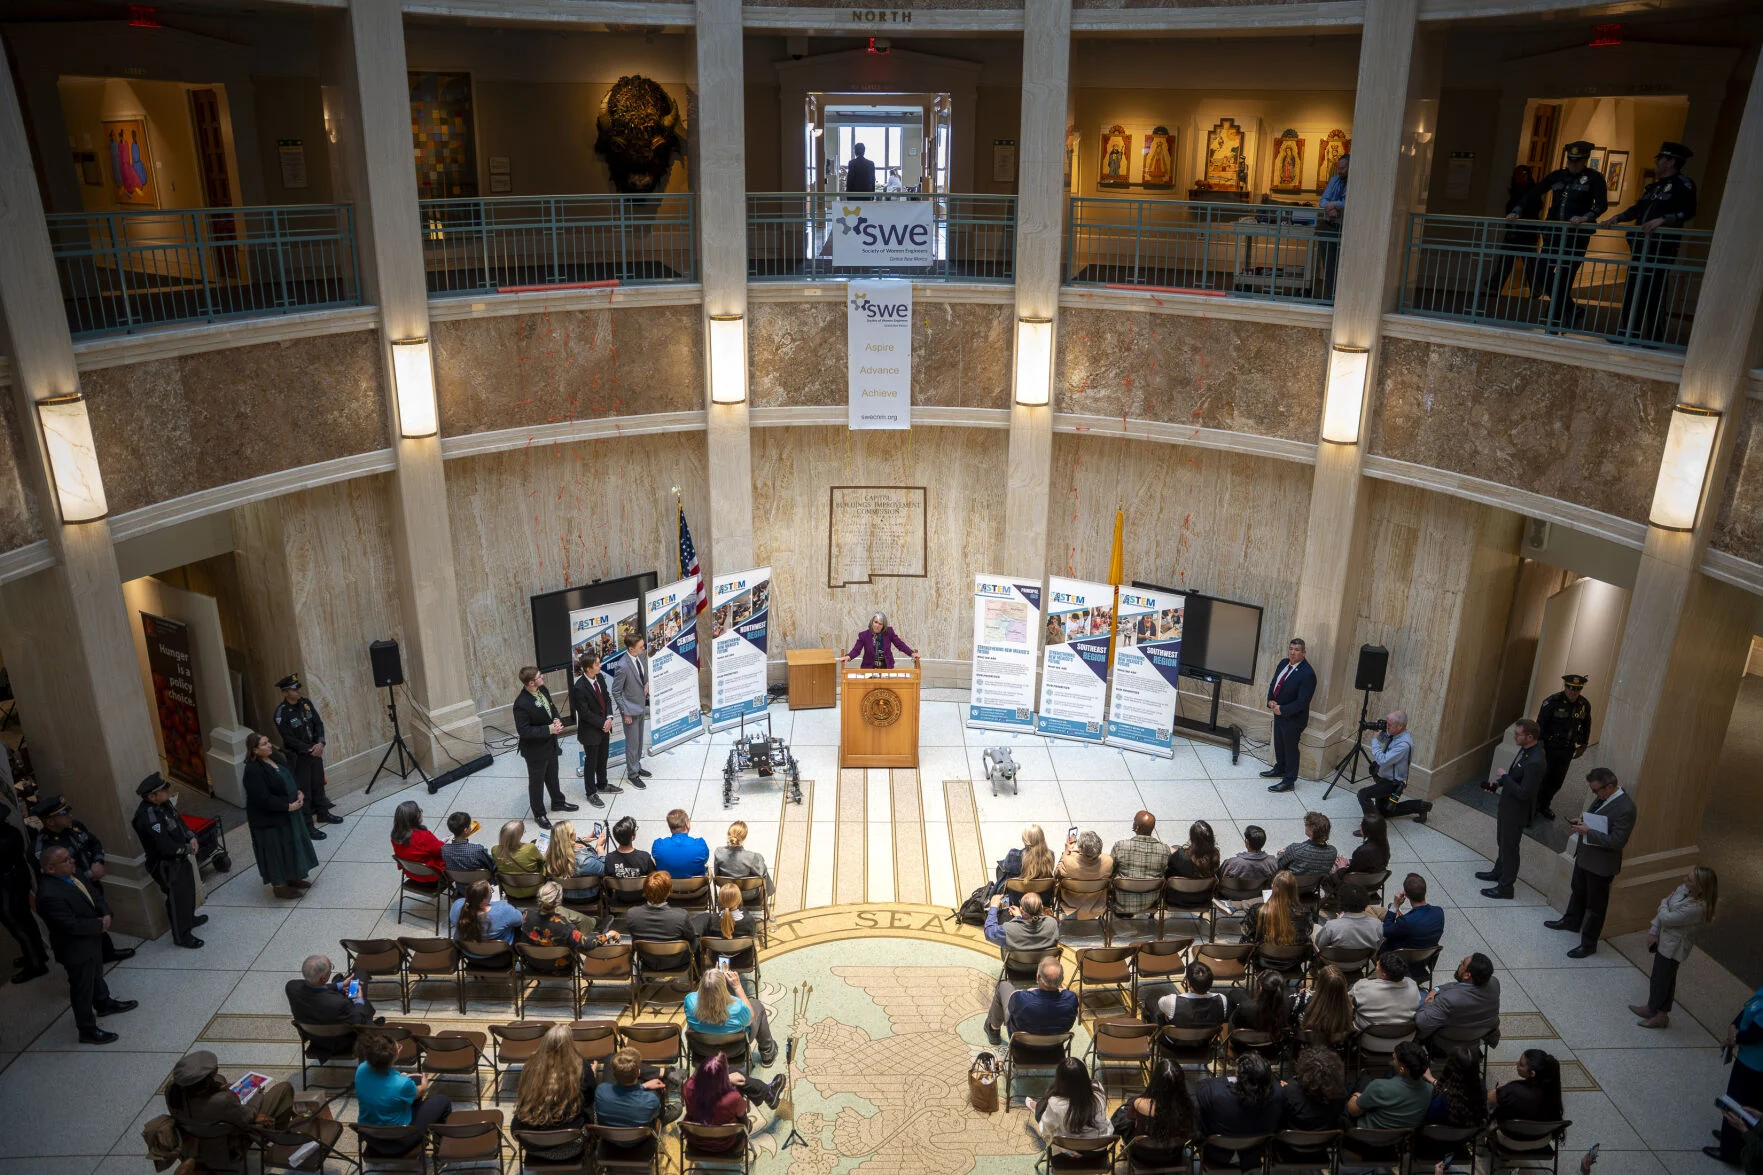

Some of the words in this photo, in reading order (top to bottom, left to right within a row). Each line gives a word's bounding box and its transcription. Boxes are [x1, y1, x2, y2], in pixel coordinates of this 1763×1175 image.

[852, 11, 912, 22] NORTH
[862, 224, 929, 246] swe
[867, 304, 908, 318] swe
[865, 343, 894, 352] Aspire
[860, 366, 899, 375] Advance
[862, 389, 897, 398] Achieve
[159, 643, 189, 662] Hunger
[1077, 643, 1107, 653] SOUTHEAST
[1147, 647, 1178, 658] SOUTHWEST
[1083, 652, 1106, 662] REGION
[1153, 656, 1177, 667] REGION
[177, 664, 184, 674] is
[169, 677, 193, 693] policy
[168, 690, 196, 707] choice.
[855, 911, 976, 939] SEAL
